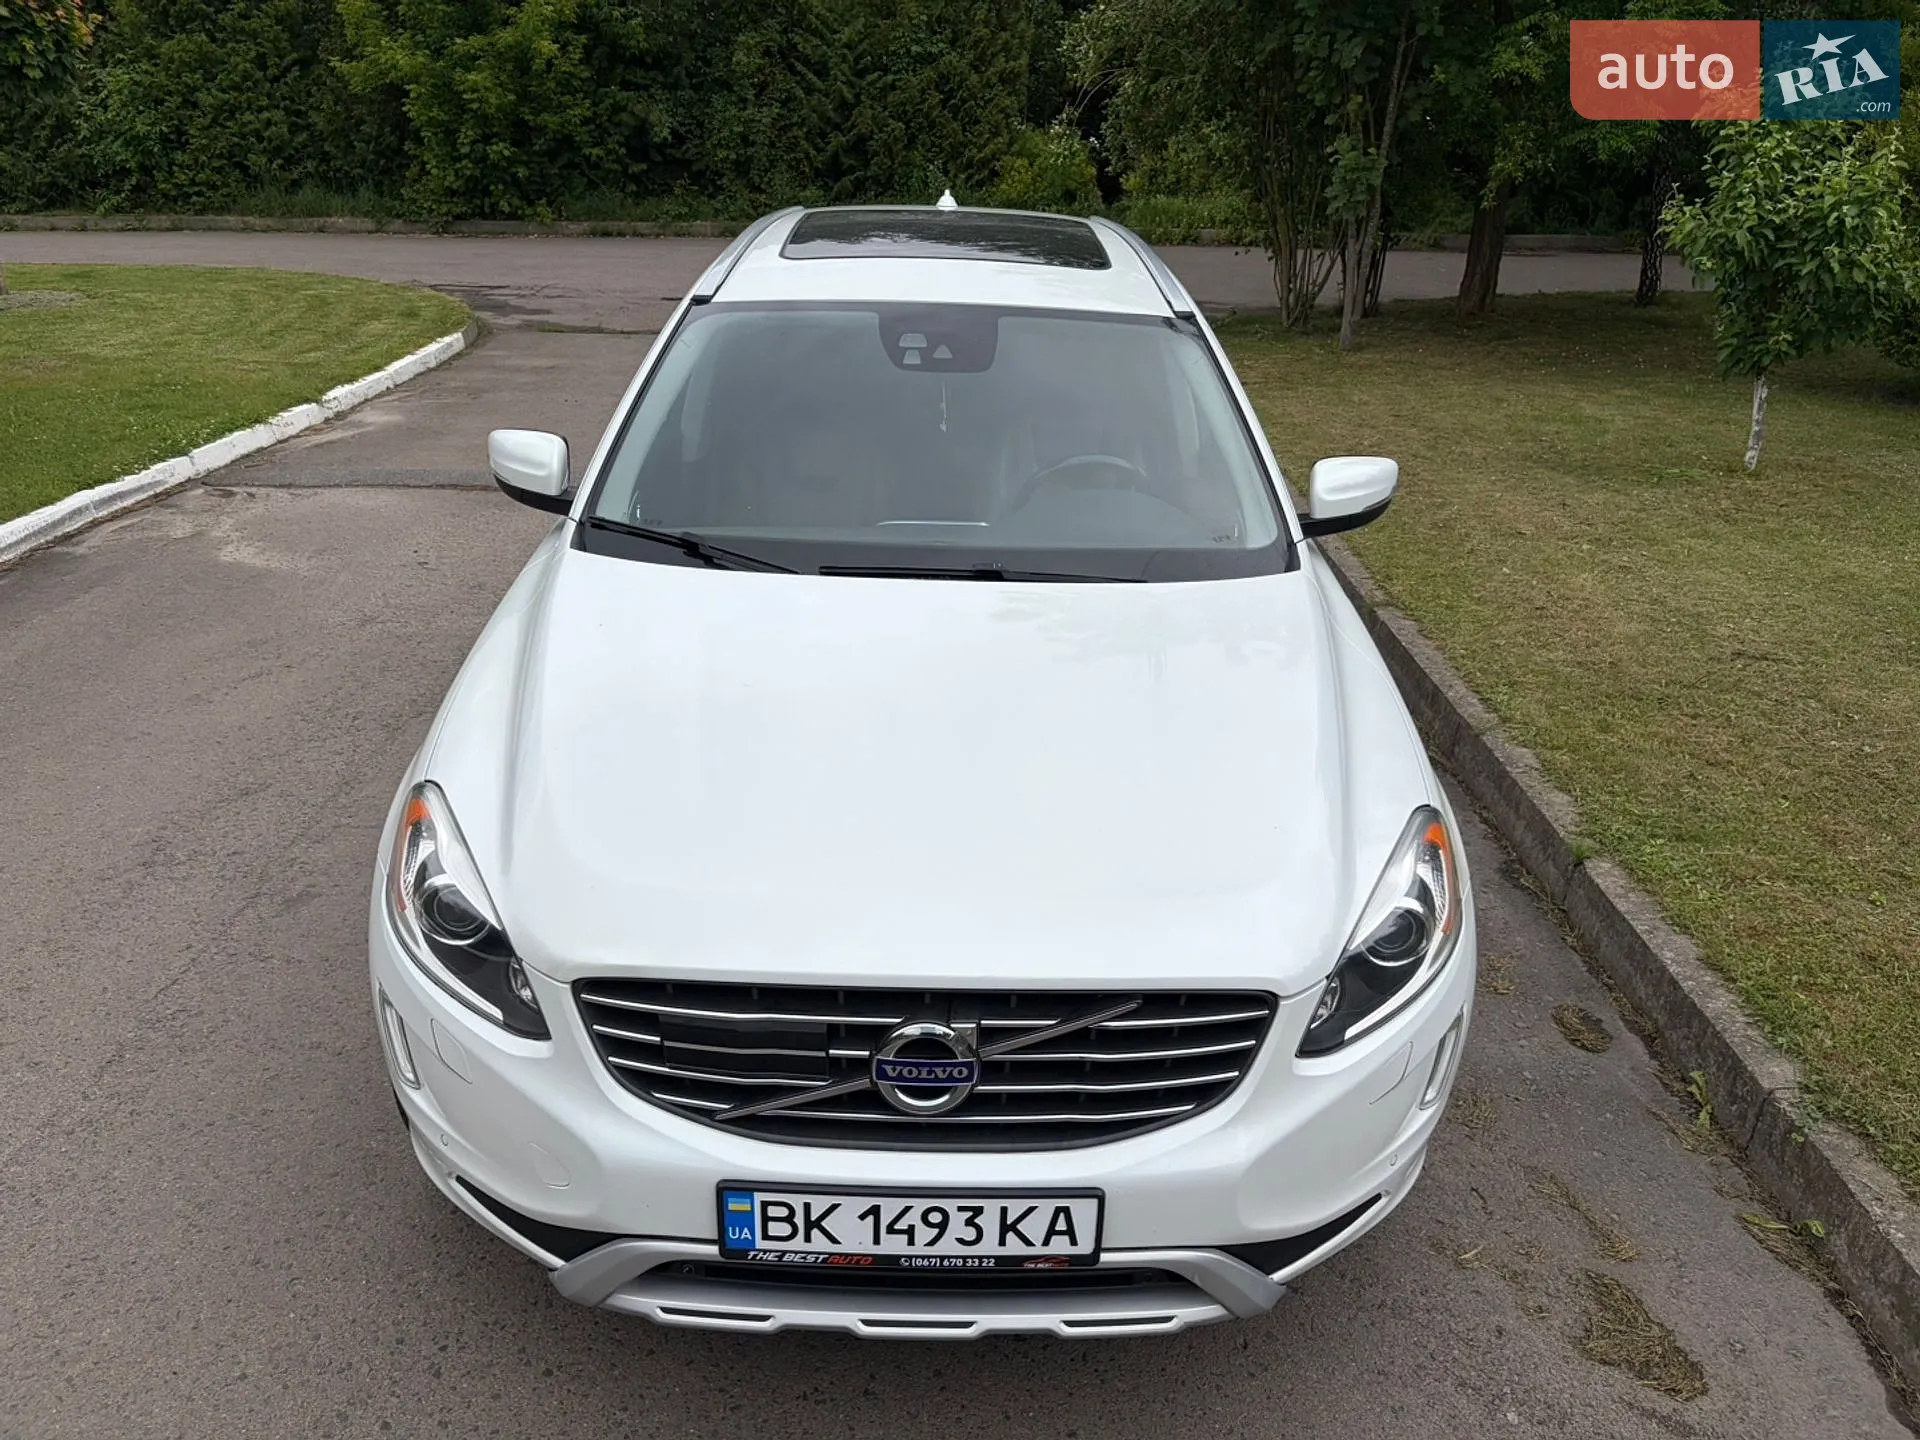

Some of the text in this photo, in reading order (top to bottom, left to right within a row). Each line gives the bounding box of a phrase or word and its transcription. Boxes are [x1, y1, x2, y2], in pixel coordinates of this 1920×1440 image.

[881, 1064, 969, 1079] VOLVO
[760, 1200, 1079, 1247] BK 1493 KA
[728, 1226, 752, 1239] UA
[747, 1251, 782, 1261] THE
[782, 1253, 829, 1263] BEST
[911, 1257, 995, 1267] (067) 670 33 22
